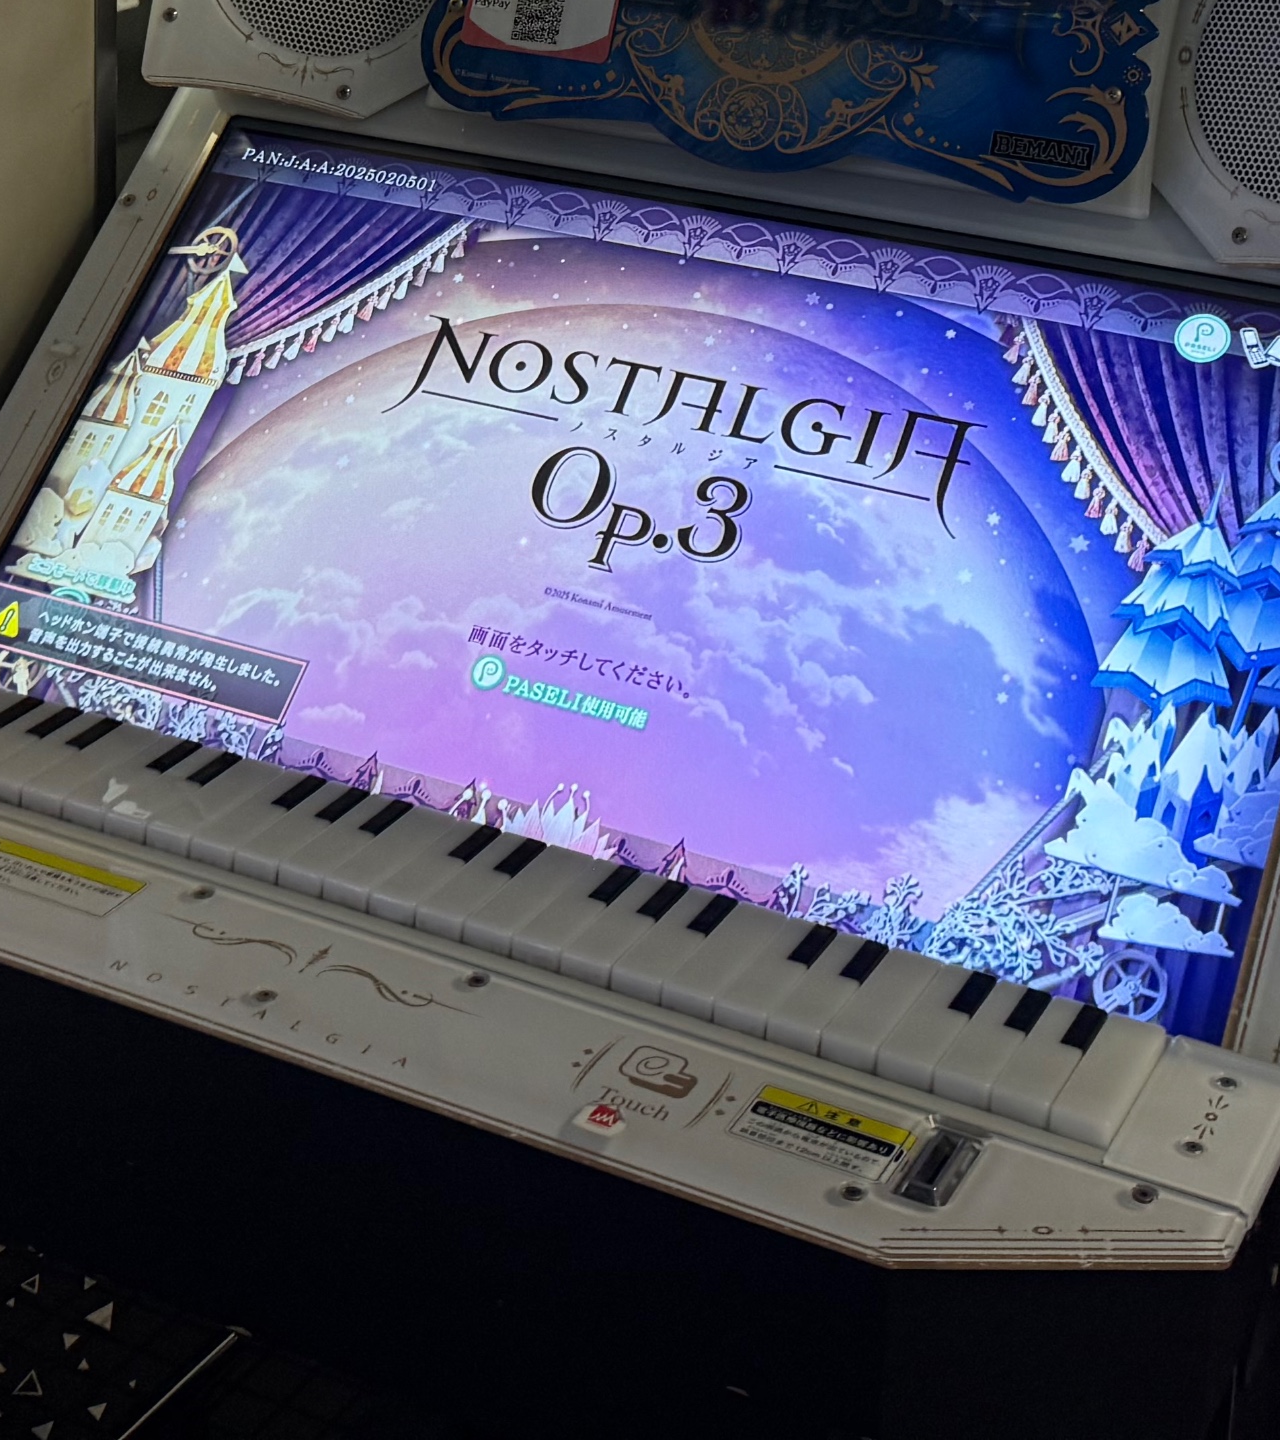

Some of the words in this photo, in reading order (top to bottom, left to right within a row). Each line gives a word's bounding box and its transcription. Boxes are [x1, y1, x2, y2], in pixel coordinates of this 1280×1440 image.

[240, 146, 438, 193] PAN:J:A:A:2025020501
[993, 133, 1090, 167] BEMANI
[380, 314, 989, 540] NOSTALGIA
[568, 418, 760, 472] ノスタルジア
[529, 445, 754, 574] Op.3
[570, 592, 604, 609] Konami
[604, 601, 652, 621] Amusement
[27, 627, 218, 692] 音声を出力することが出来ません。
[37, 611, 281, 688] ヘッドホン端子で接続異常が発生しました。
[467, 624, 691, 699] 画面をタッチしてください。
[501, 674, 649, 730] PASELI使用可能
[593, 1085, 671, 1124] Touch
